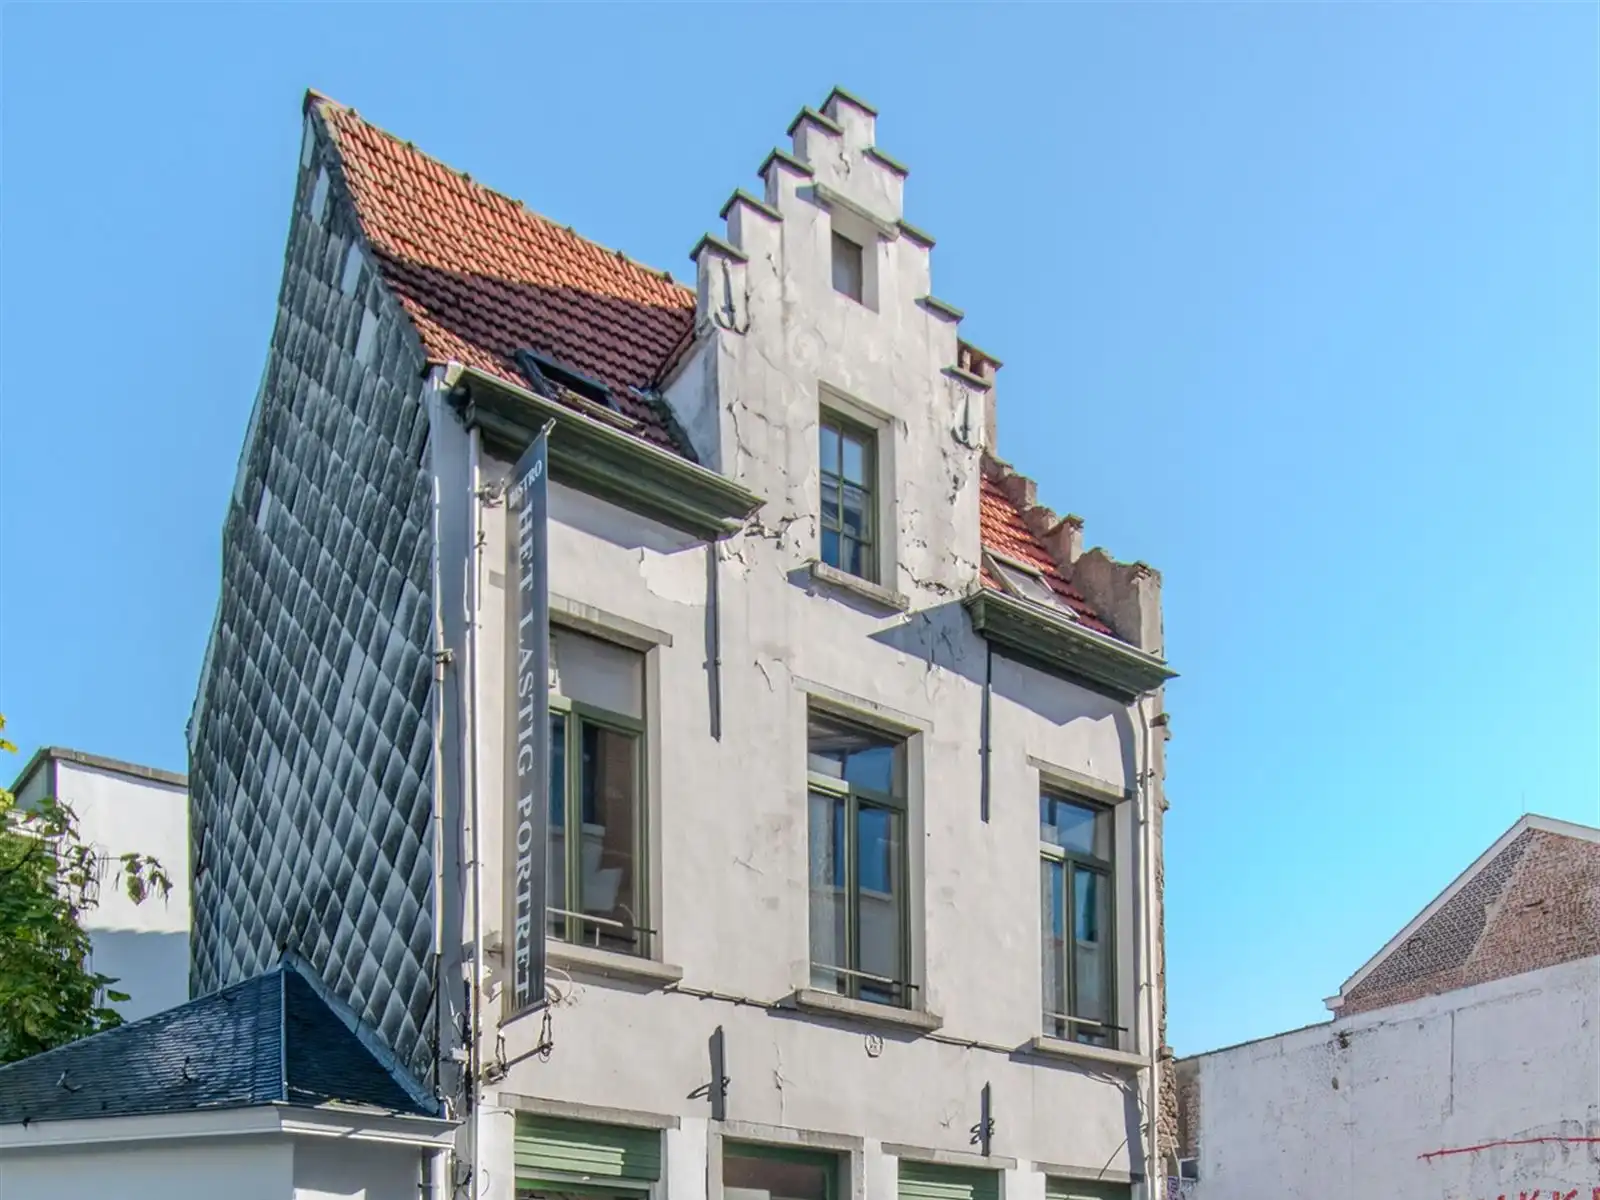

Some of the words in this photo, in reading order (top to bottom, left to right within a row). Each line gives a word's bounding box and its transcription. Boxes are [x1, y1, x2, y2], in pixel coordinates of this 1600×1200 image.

[518, 500, 534, 592] HET
[517, 608, 534, 778] LASTIG
[515, 793, 533, 1007] PORTRET
